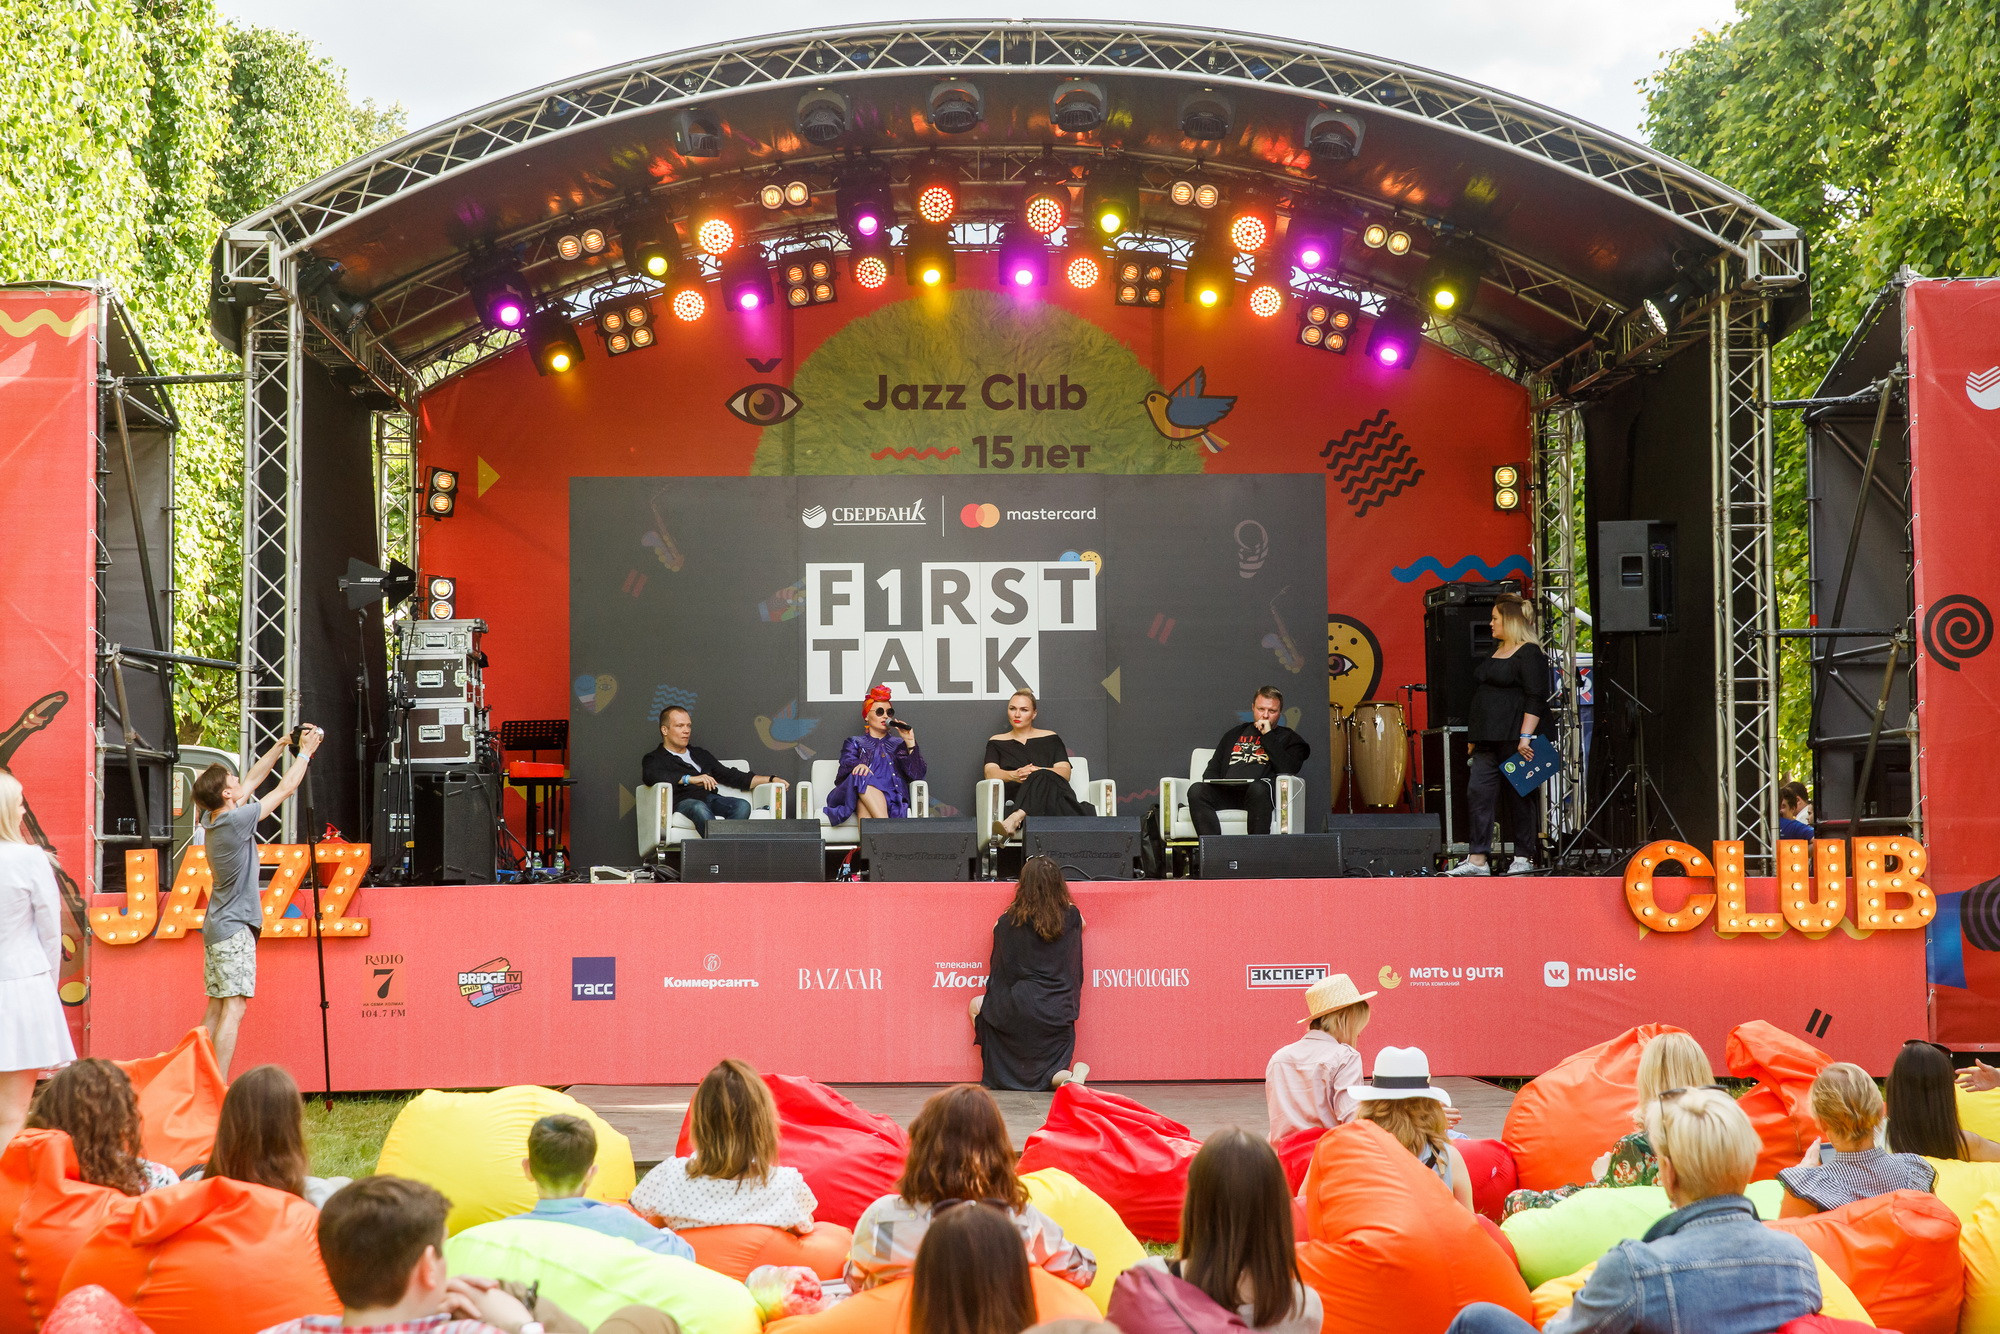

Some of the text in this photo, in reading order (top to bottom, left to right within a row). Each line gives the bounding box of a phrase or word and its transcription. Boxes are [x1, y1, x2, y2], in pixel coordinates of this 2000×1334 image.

[863, 373, 1088, 412] Jazz Club
[972, 435, 1091, 469] 15 лет
[818, 567, 1091, 627] F1RST
[812, 636, 1034, 696] TALK
[1625, 835, 1937, 933] CLUB
[89, 843, 371, 945] JAZZ
[365, 954, 404, 966] RADIO
[934, 961, 983, 969] телеканал
[508, 974, 520, 982] TV
[797, 968, 883, 991] BAZAAR
[932, 971, 990, 988] Моск
[1092, 967, 1190, 988] PSYCHOLOGIES
[1251, 968, 1325, 981] ЭКСПЕРТ
[1409, 966, 1449, 979] мать
[1452, 966, 1463, 979] и
[1576, 963, 1637, 982] music
[373, 968, 395, 999] 7
[462, 984, 480, 994] THIS
[495, 984, 519, 995] MUSIC
[663, 976, 760, 990] Коммерсантъ
[361, 1008, 406, 1018] 104.7 FM
